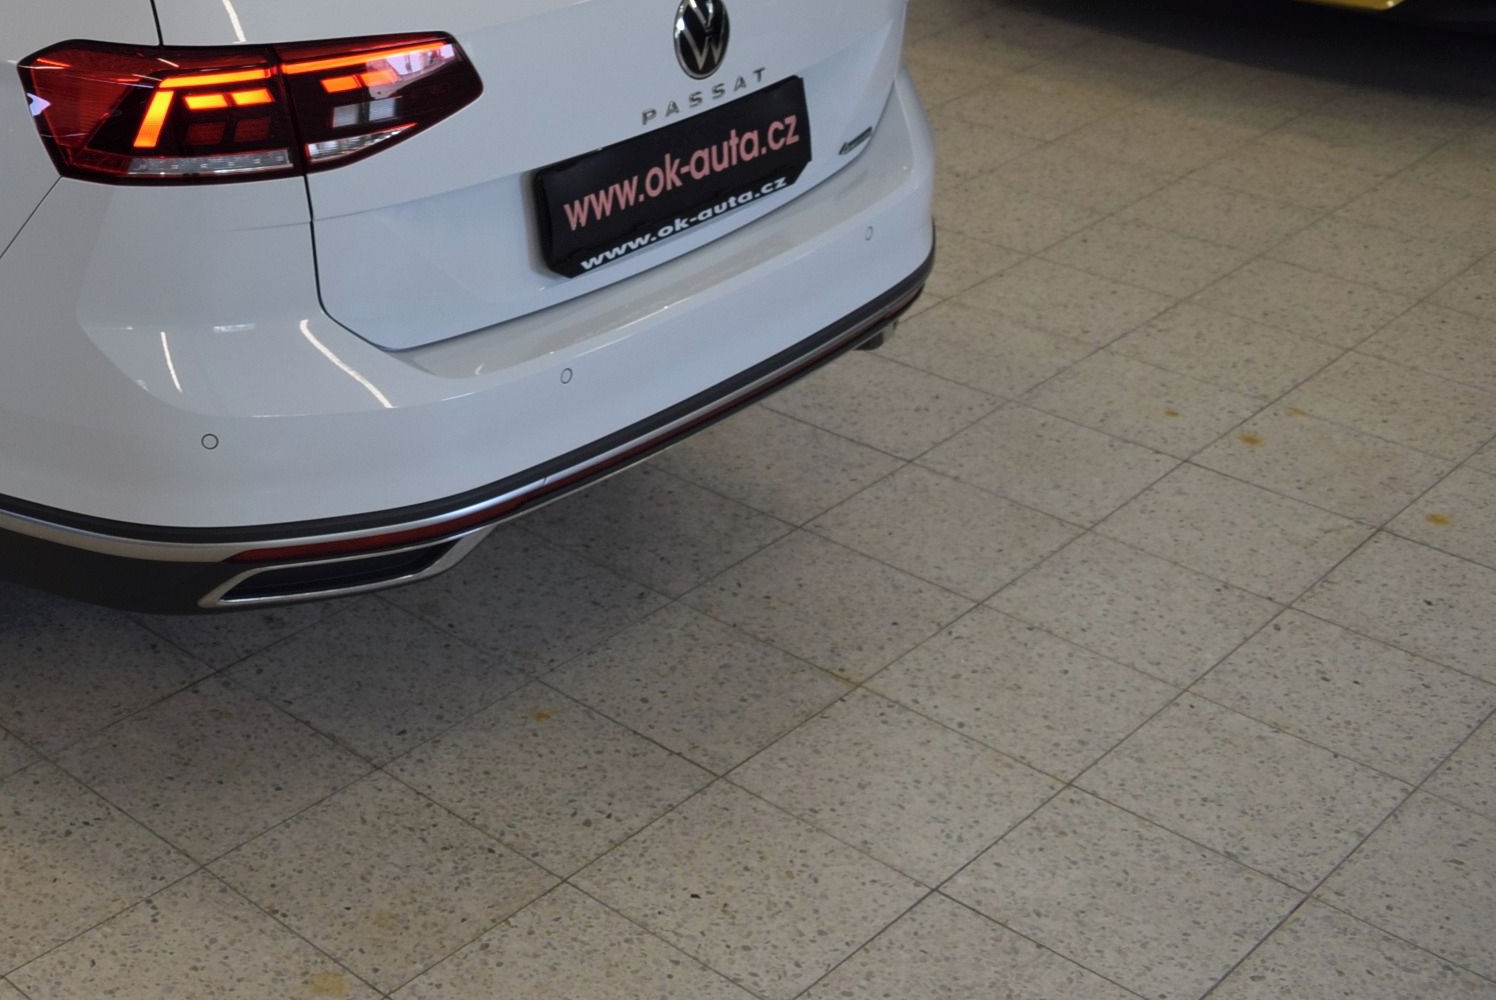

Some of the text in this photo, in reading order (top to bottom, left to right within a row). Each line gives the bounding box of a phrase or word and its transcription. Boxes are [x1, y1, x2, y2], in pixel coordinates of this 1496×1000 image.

[641, 67, 767, 126] PASSAT
[563, 114, 799, 231] www.ok-auta.cz
[580, 175, 787, 271] www.ok-auta.cz
